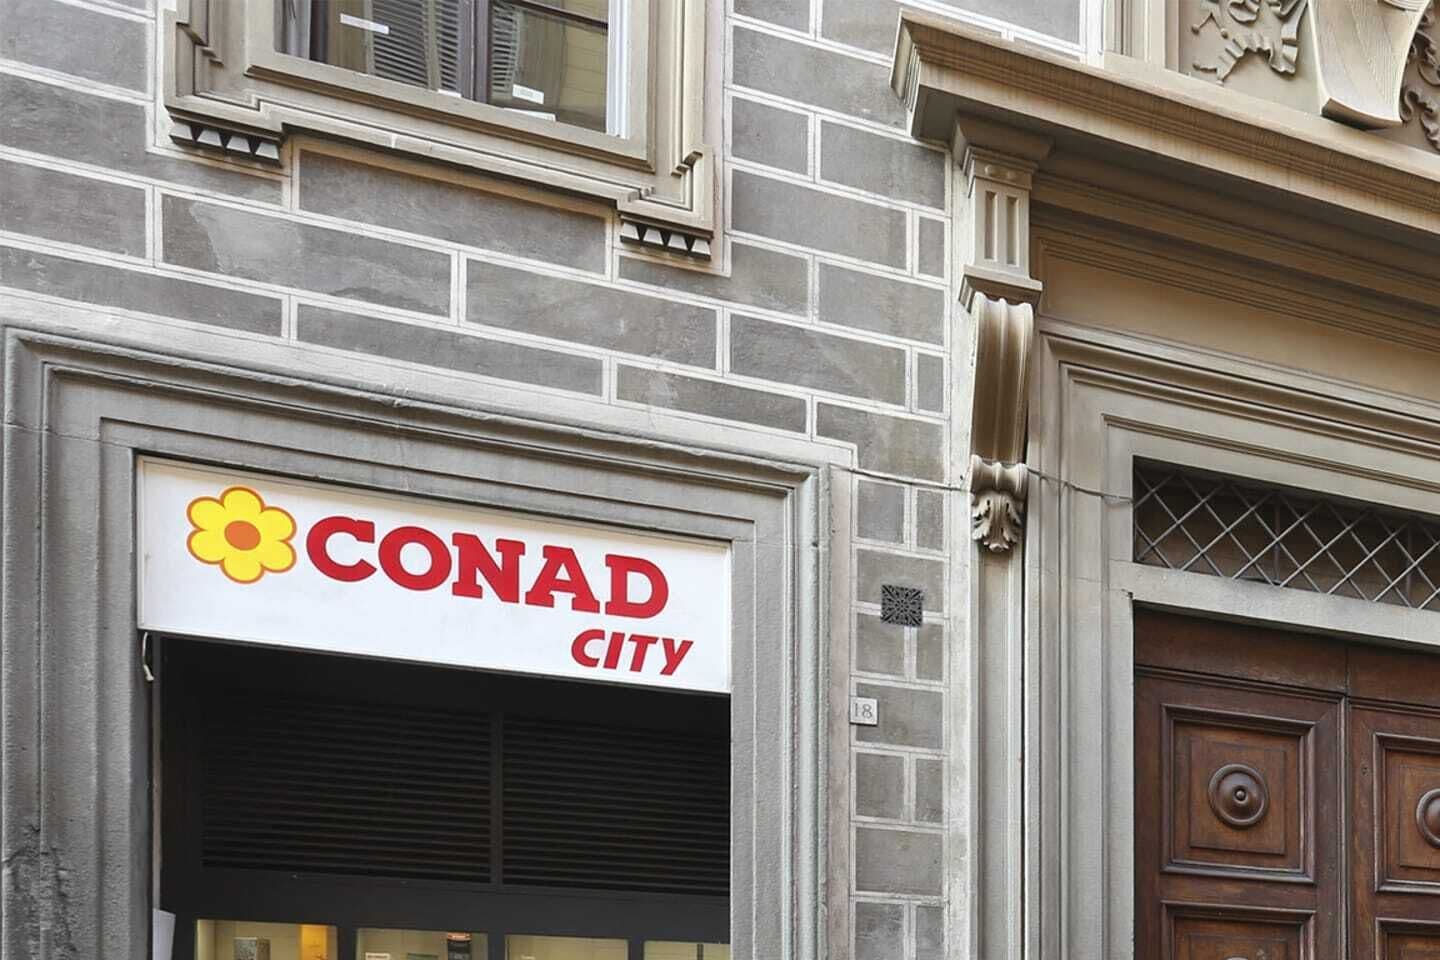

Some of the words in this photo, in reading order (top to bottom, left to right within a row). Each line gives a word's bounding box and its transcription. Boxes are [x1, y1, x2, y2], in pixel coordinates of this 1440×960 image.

[305, 515, 669, 620] CONAD
[571, 629, 694, 677] CITY
[853, 702, 873, 719] 18
